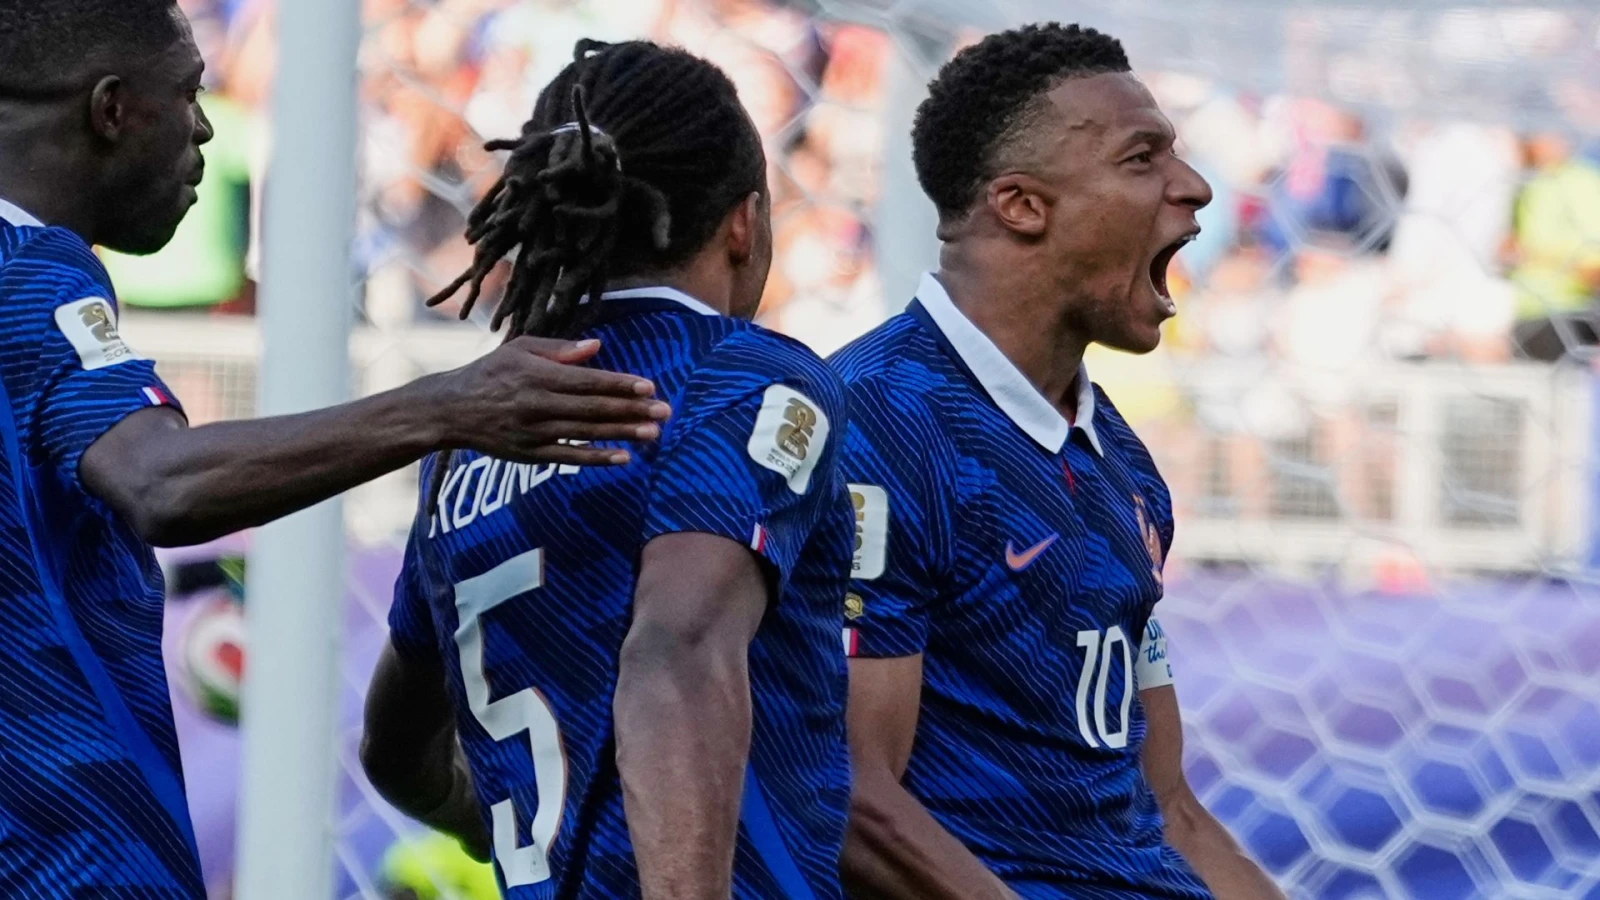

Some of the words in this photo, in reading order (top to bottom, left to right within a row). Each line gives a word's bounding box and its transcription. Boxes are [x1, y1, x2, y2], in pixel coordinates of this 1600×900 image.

[104, 347, 132, 362] 202
[453, 547, 568, 889] 5
[1076, 625, 1133, 748] 10
